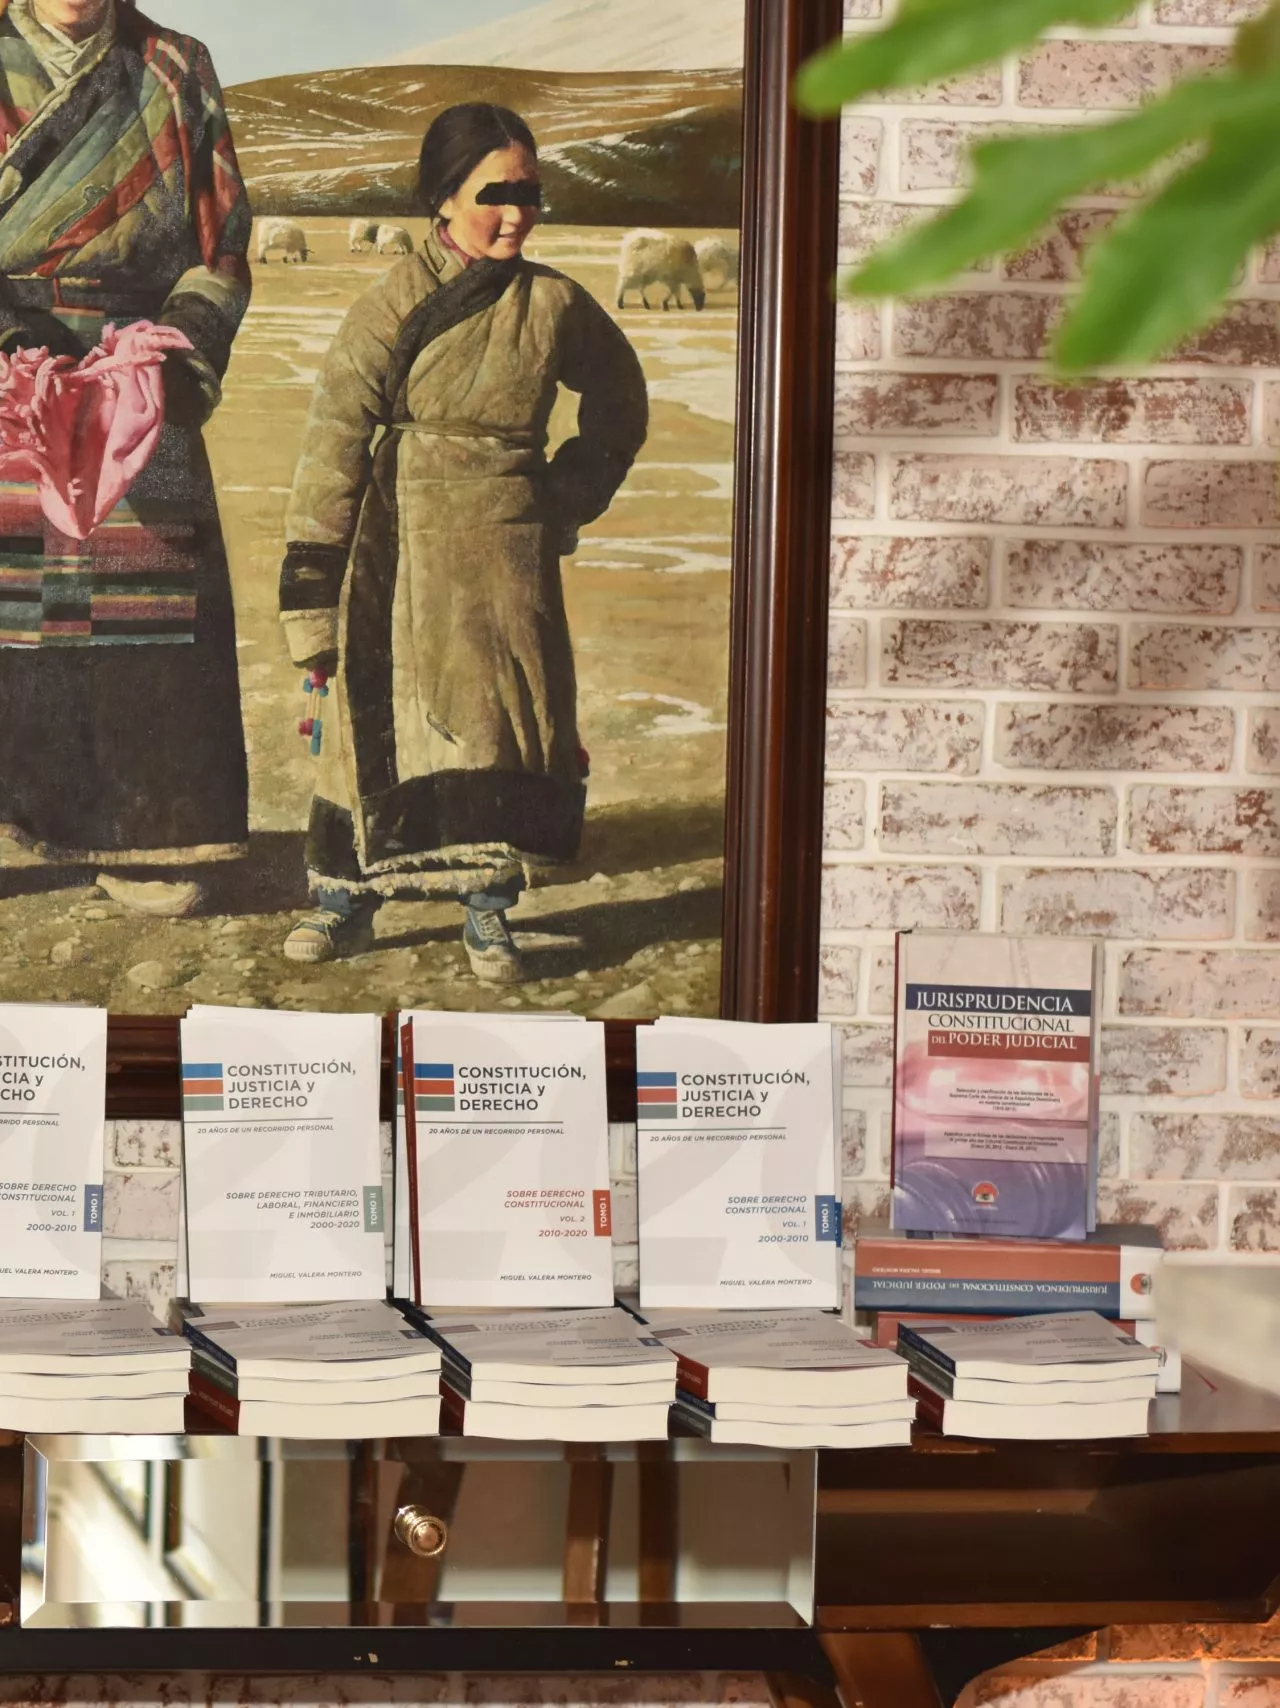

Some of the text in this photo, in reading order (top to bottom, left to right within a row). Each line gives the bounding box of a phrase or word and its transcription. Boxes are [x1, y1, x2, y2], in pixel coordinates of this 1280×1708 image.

[916, 991, 1074, 1012] JURISPRUDENCIA
[928, 1013, 1074, 1032] CONSTITUCIONAL
[931, 1032, 1077, 1050] DEL PODER JUDICIAL
[227, 1059, 356, 1078] CONSTITUCIÓN,
[458, 1064, 587, 1080] CONSTITUCIÓN,
[35, 1075, 44, 1087] y
[681, 1069, 810, 1086] CONSTITUCIÓN,
[228, 1079, 315, 1093] JUSTICIA y
[459, 1083, 546, 1097] JUSTICIA y
[681, 1089, 769, 1103] JUSTICIA y
[229, 1095, 308, 1110] DERECHO
[459, 1098, 539, 1111] DERECHO
[682, 1105, 761, 1118] DERECHO
[208, 1126, 228, 1134] AÑOS
[253, 1125, 295, 1133] RECORRIDO
[439, 1127, 459, 1135] AÑOS
[32, 1183, 77, 1192] DERECHO
[226, 1189, 358, 1200] SOBRE DERECHO TRIBUTARIO,
[506, 1190, 585, 1198] SOBRE DERECHO
[504, 1200, 585, 1208] CONSTITUCIONAL
[727, 1195, 807, 1204] SOBRE DERECHO
[256, 1200, 359, 1210] LABORAL, FINANCIERO
[725, 1206, 807, 1214] CONSTITUCIONAL
[90, 1198, 98, 1224] TOMO
[296, 1210, 360, 1219] INMOBILIARIO
[310, 1221, 360, 1229] 2000-2020
[821, 1208, 829, 1234] TOMO
[26, 1223, 77, 1232] 2000-2010
[538, 1229, 588, 1237] 2010-2020
[758, 1234, 809, 1243] 2000-2010
[327, 1270, 363, 1278] MONTERO
[872, 1281, 913, 1289] JUDICIAL
[915, 1281, 946, 1290] PODER
[962, 1283, 1034, 1292] CONSTITUCIONAL
[1036, 1284, 1107, 1294] JURISPRUDENCIA
